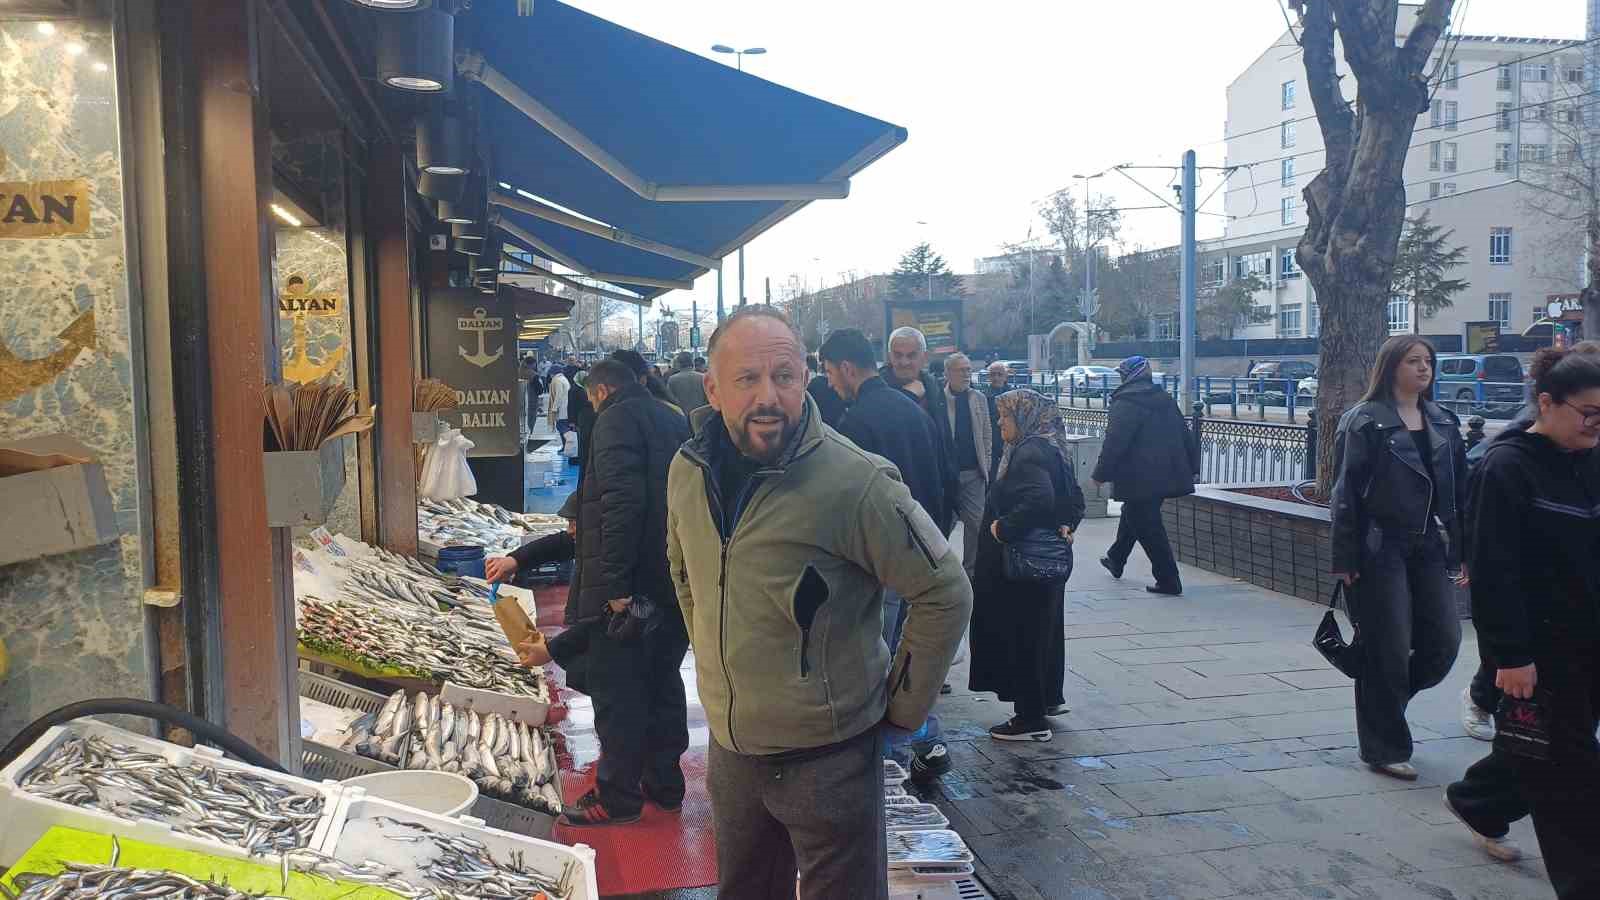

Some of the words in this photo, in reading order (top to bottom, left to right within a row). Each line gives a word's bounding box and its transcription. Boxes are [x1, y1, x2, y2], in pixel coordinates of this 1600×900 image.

[0, 193, 77, 224] AN
[460, 319, 501, 329] DALYAN
[455, 389, 511, 405] DALYAN
[462, 412, 506, 427] BALIK
